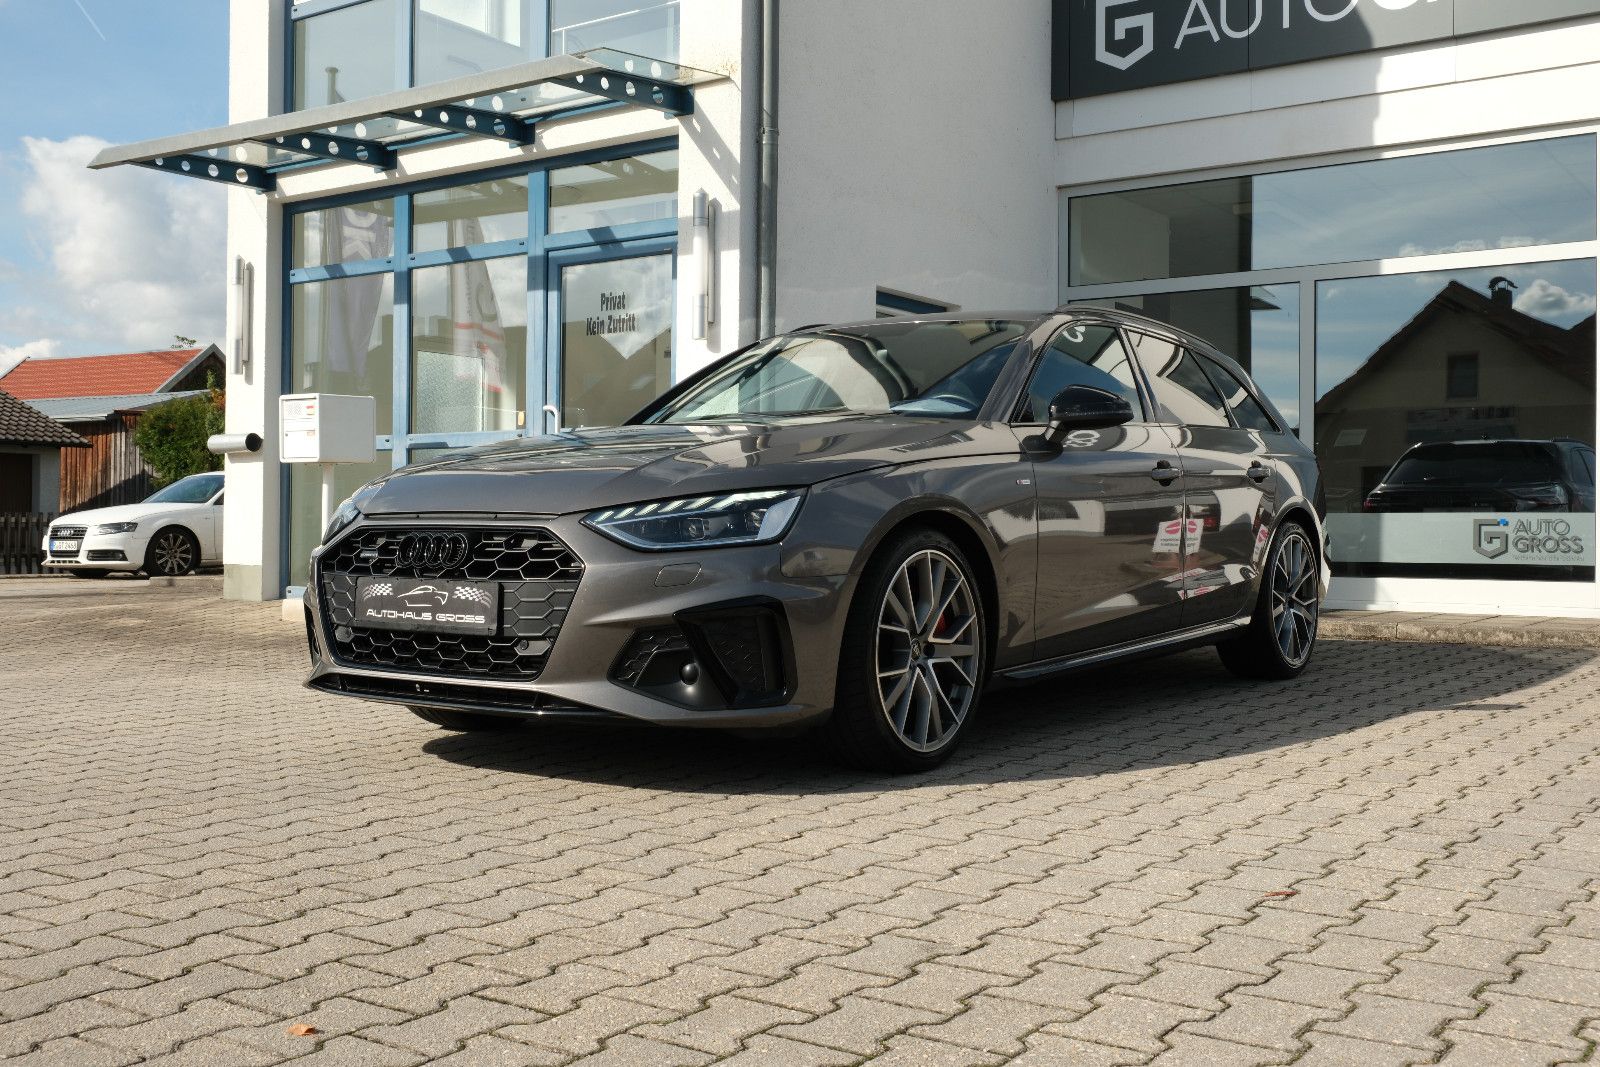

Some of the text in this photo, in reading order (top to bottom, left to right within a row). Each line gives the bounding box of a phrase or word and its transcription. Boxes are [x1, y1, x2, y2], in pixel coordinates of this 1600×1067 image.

[600, 292, 626, 311] Privat
[586, 312, 636, 336] Kein Zutritt
[1513, 519, 1571, 535] AUTO
[1512, 536, 1584, 554] GROSS
[366, 608, 485, 624] AUTOHAUS GROSS
